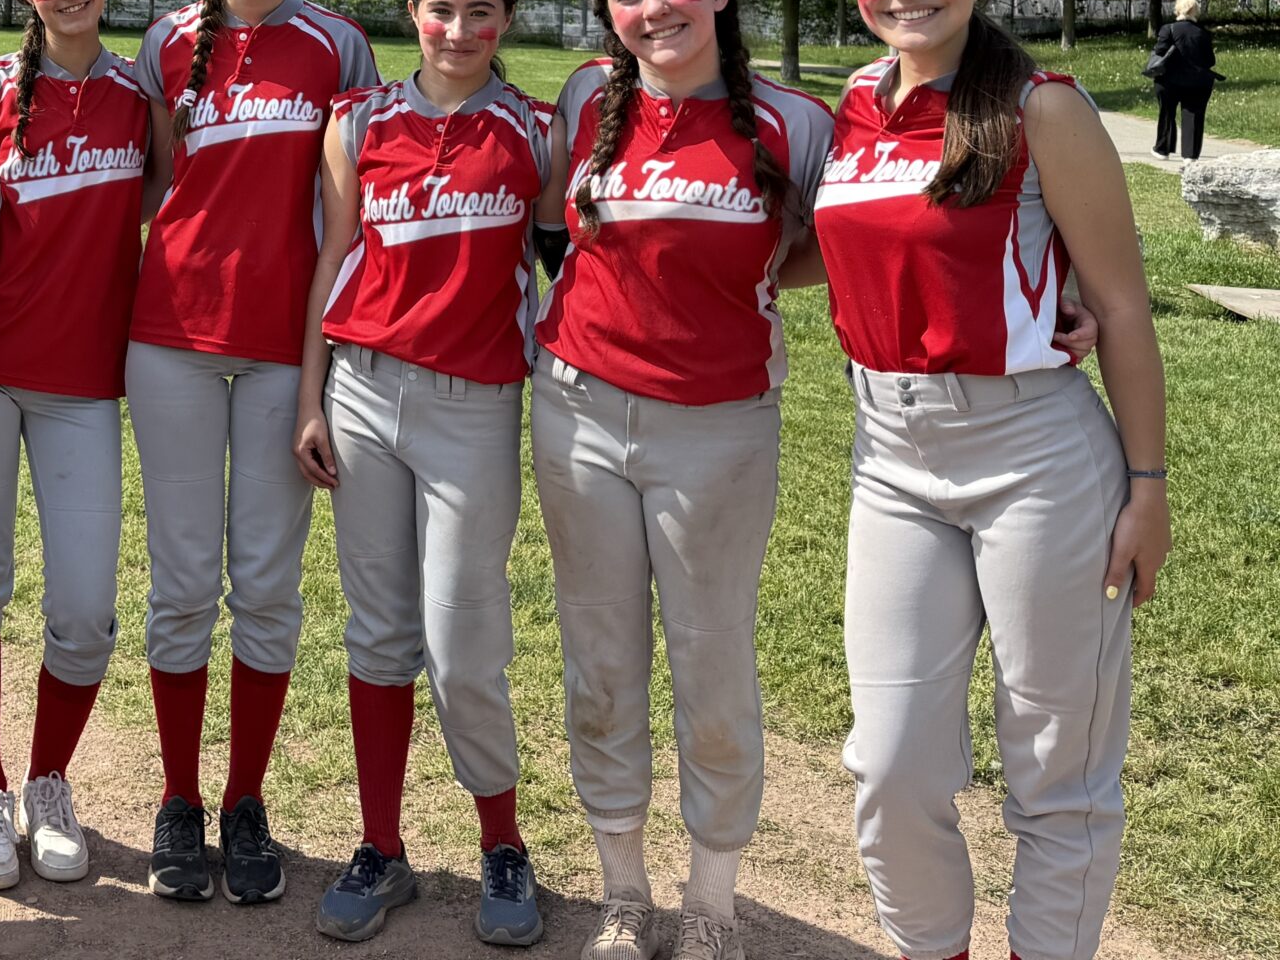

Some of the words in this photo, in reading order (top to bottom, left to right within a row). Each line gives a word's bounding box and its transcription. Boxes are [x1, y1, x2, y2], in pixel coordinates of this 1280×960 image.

[225, 82, 314, 122] Toronto
[65, 135, 141, 173] Toronto
[860, 140, 941, 183] Toron
[363, 181, 415, 223] North
[421, 174, 517, 218] Toronto
[633, 159, 752, 212] Toronto
